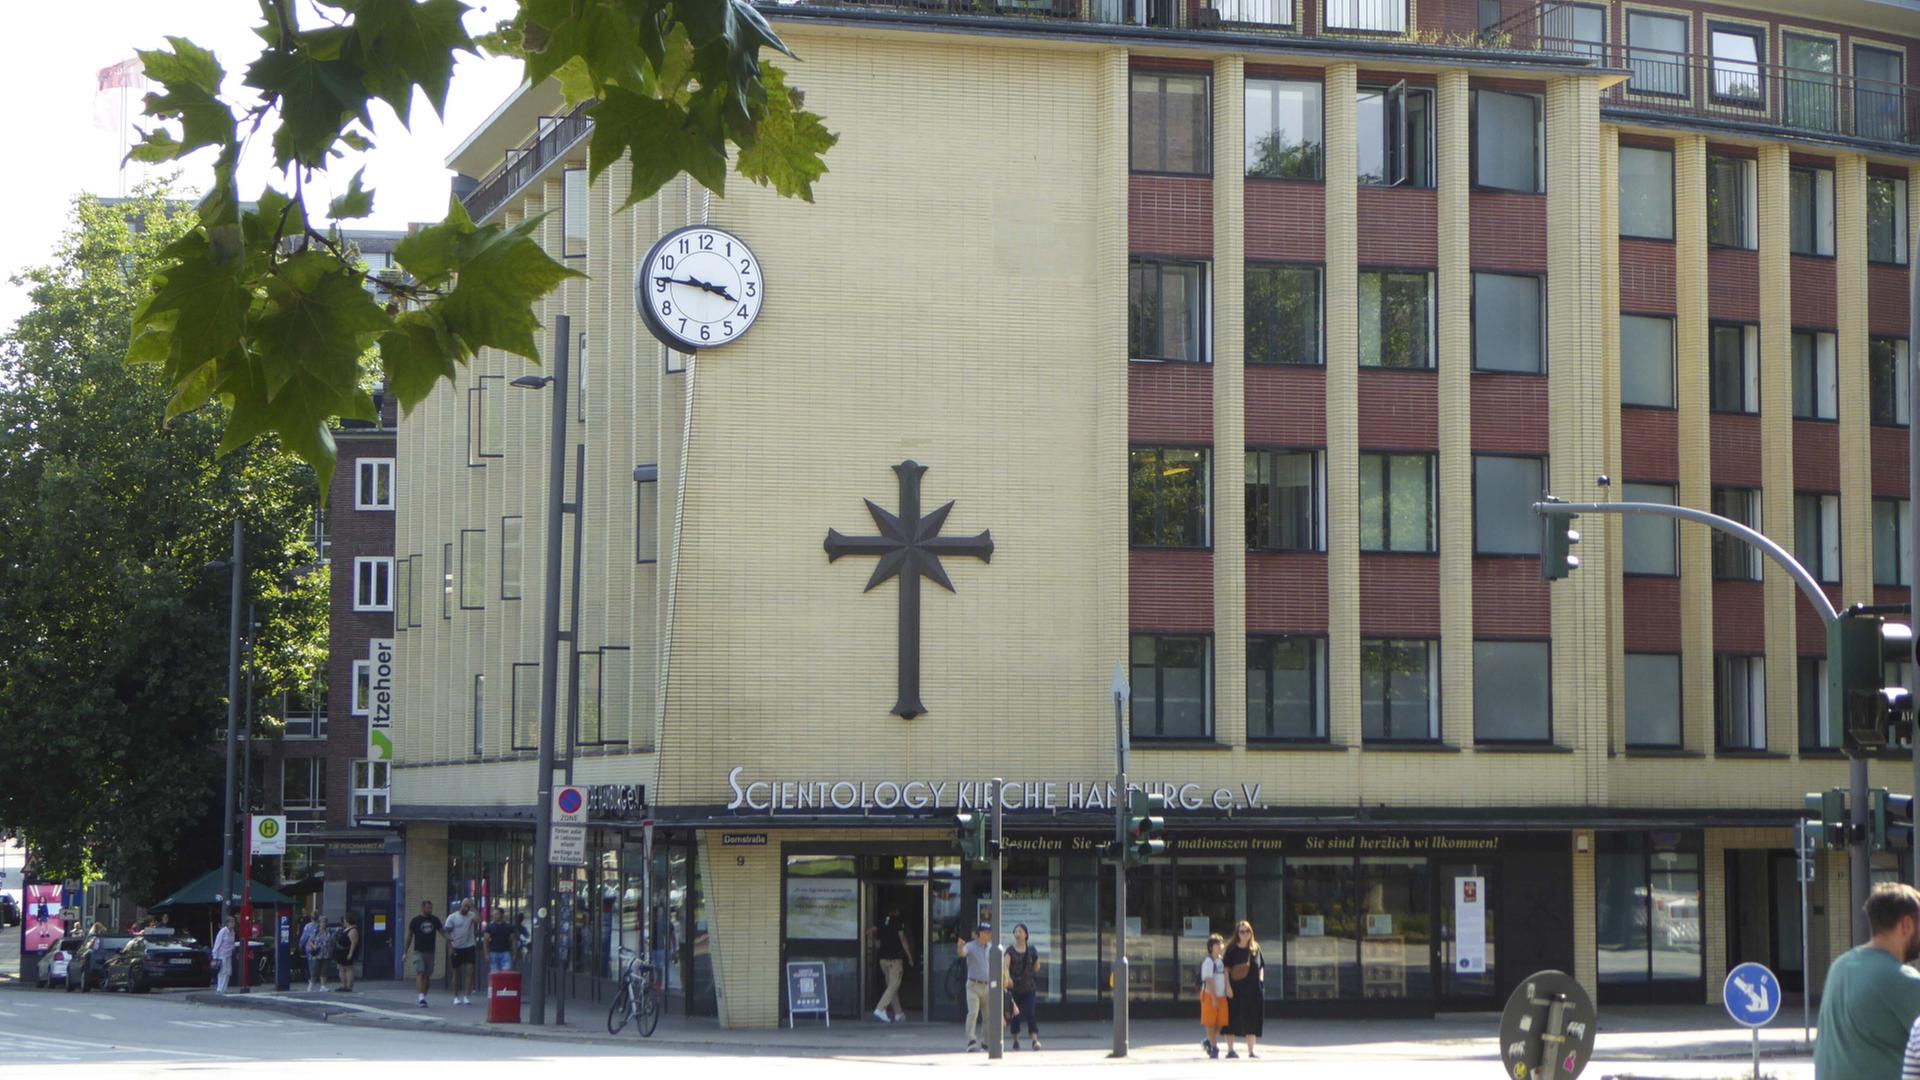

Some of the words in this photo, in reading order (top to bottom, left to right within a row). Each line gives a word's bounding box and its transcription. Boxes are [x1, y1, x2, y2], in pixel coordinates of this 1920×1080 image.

[678, 238, 689, 254] 11
[699, 234, 714, 250] 12
[725, 241, 731, 257] 1
[660, 254, 674, 270] 10
[740, 258, 750, 274] 2
[656, 278, 666, 293] 9
[745, 282, 756, 297] 3
[661, 300, 672, 316] 8
[736, 304, 749, 319] 4
[678, 318, 687, 334] 7
[700, 325, 710, 340] 6
[723, 321, 733, 336] 5
[372, 642, 392, 728] Itzehoer
[727, 766, 946, 810] SCIENTOLOGY
[959, 782, 1058, 810] KIRCHE
[1211, 783, 1268, 811] e.V.
[1001, 836, 1062, 849] Besuchen
[1072, 836, 1092, 849] Sie
[1306, 836, 1325, 849] Sie
[1328, 836, 1355, 849] sind
[1360, 836, 1410, 849] herzlich
[736, 855, 745, 866] 9
